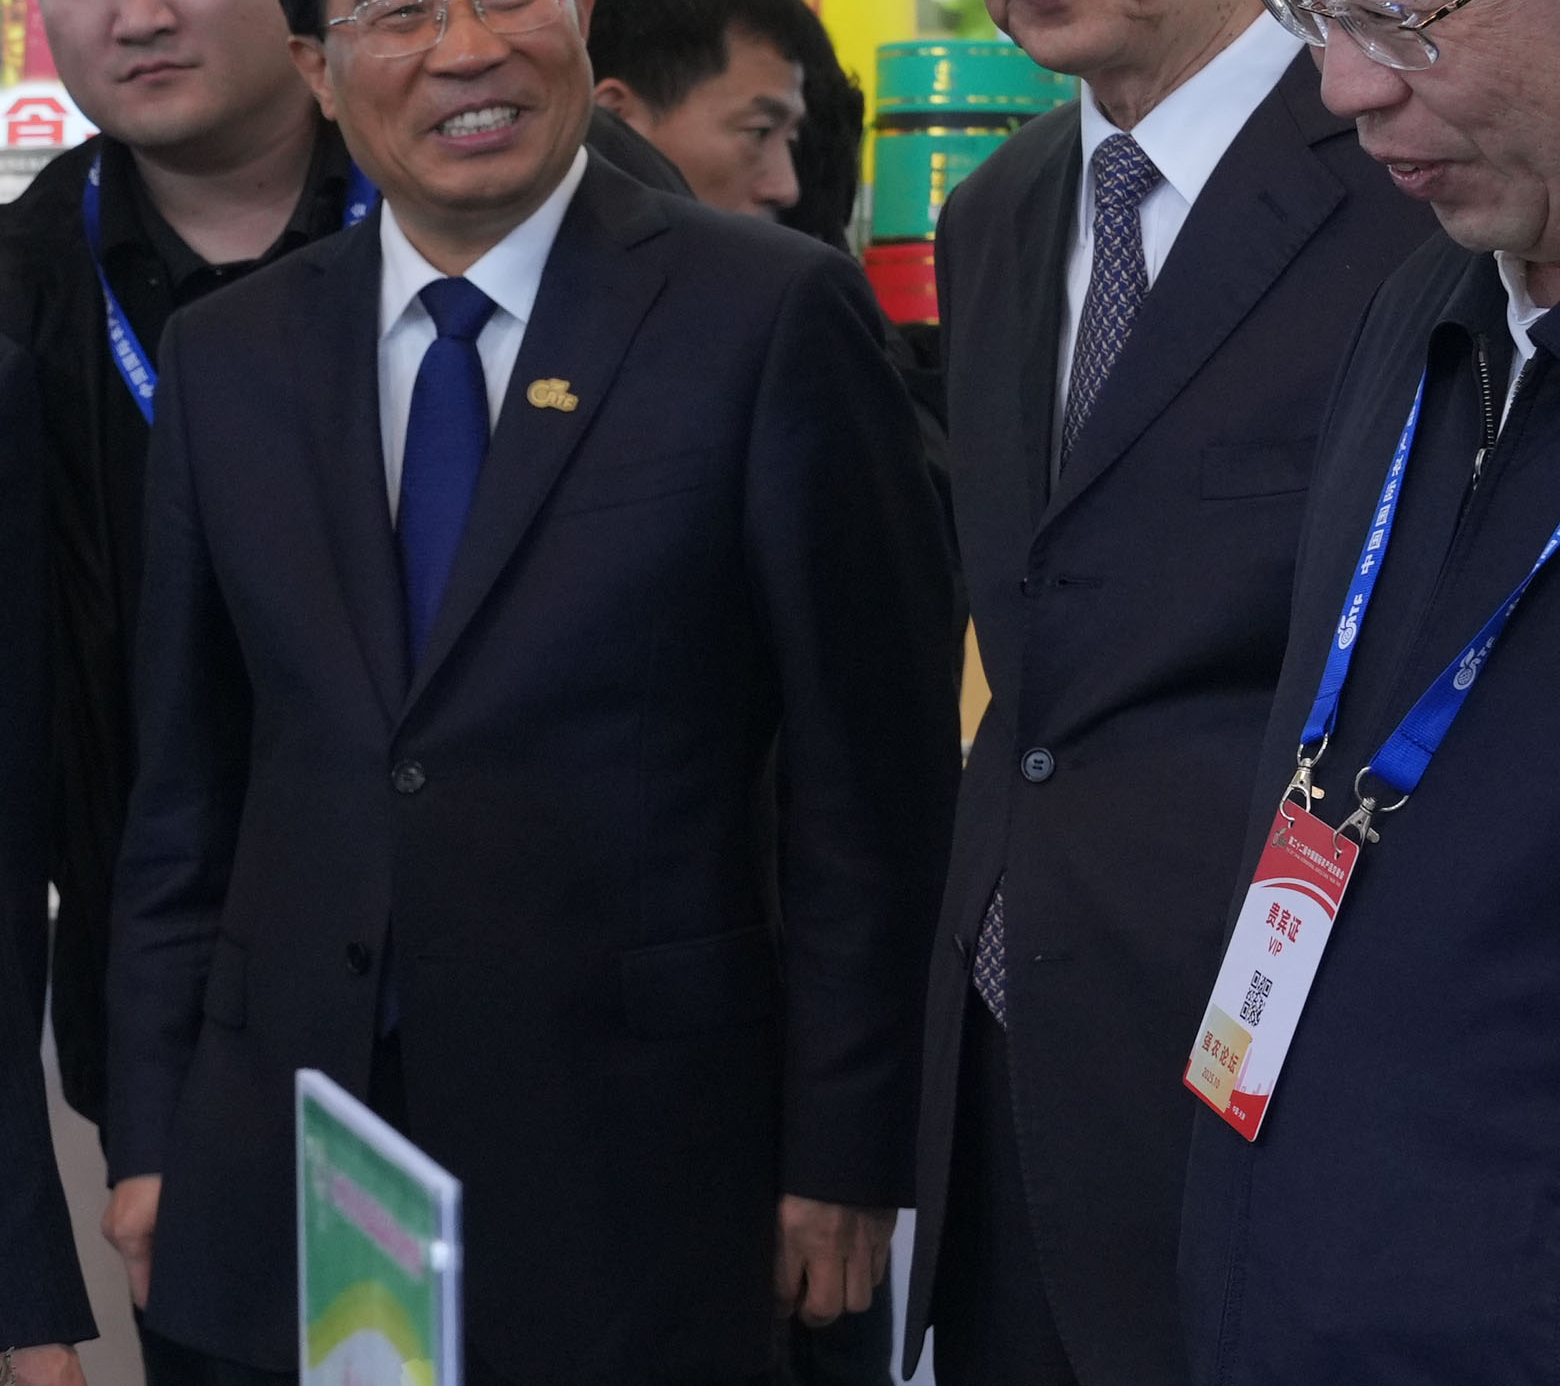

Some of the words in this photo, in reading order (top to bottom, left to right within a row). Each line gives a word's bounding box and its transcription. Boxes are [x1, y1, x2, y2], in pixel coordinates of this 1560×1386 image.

[1266, 902, 1302, 944] 贵宾证
[1267, 936, 1283, 957] VIP
[1203, 1030, 1240, 1075] 强农论坛
